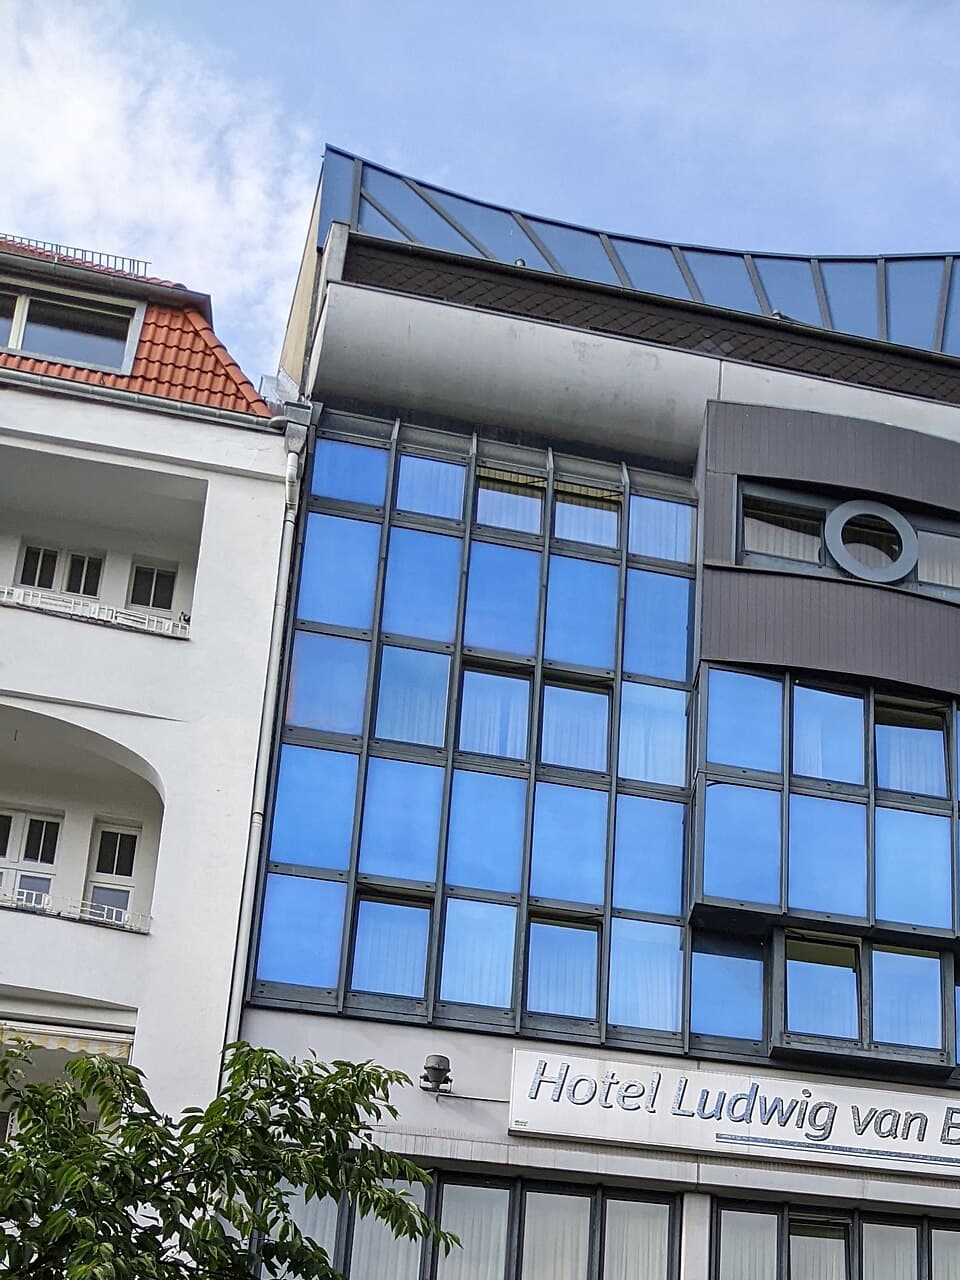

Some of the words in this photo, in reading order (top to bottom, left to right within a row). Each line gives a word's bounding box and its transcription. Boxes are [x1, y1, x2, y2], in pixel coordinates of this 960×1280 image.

[527, 1058, 662, 1114] Hotel
[671, 1076, 839, 1142] Ludwig
[850, 1104, 929, 1142] van
